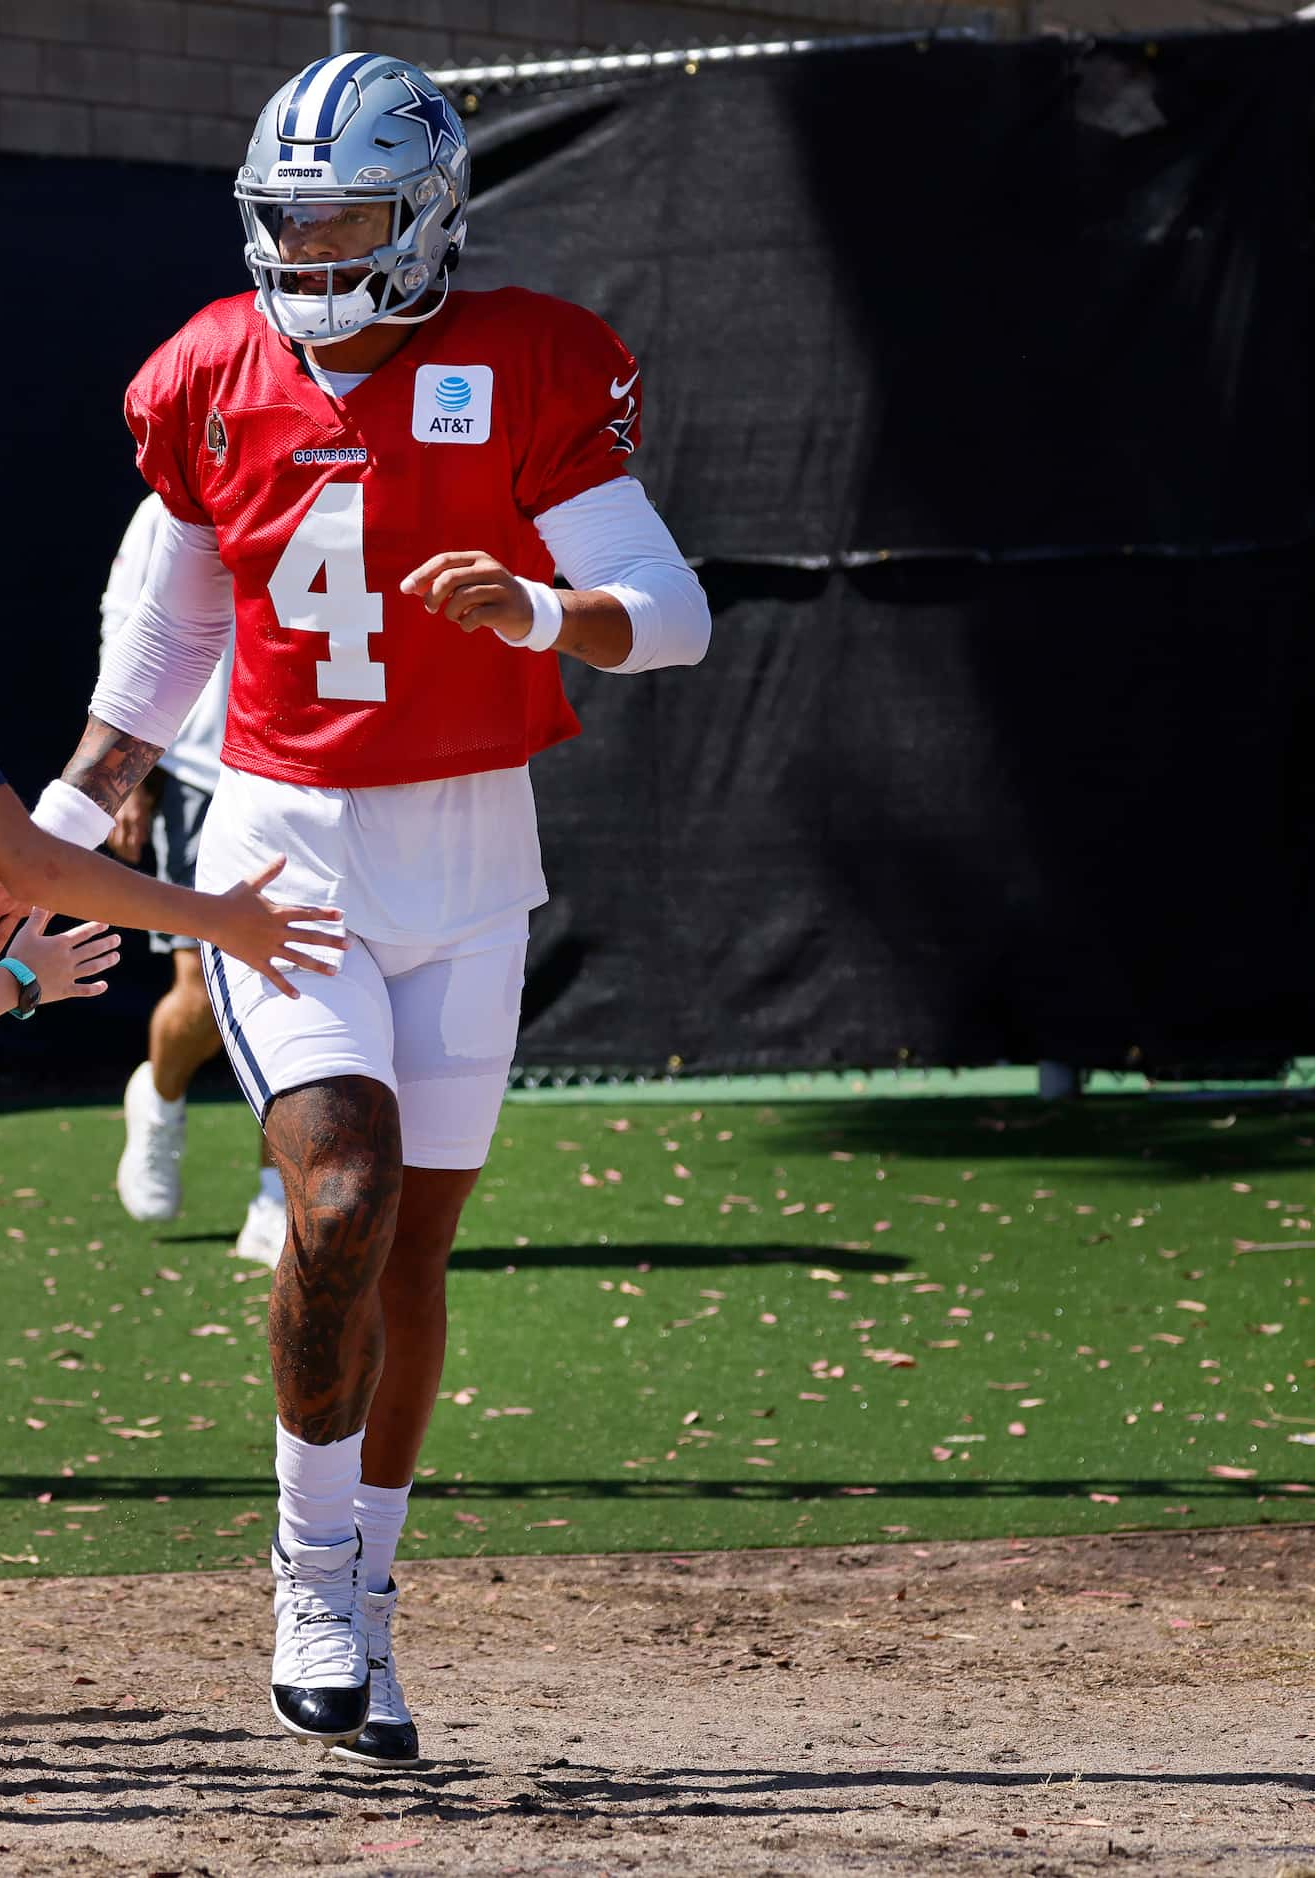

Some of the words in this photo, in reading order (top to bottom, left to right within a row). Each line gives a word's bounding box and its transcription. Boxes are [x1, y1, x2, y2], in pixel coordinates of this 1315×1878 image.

[277, 168, 323, 178] COWBOYS
[429, 417, 475, 434] AT&T
[293, 448, 367, 464] COWBOYS
[267, 482, 386, 702] 4
